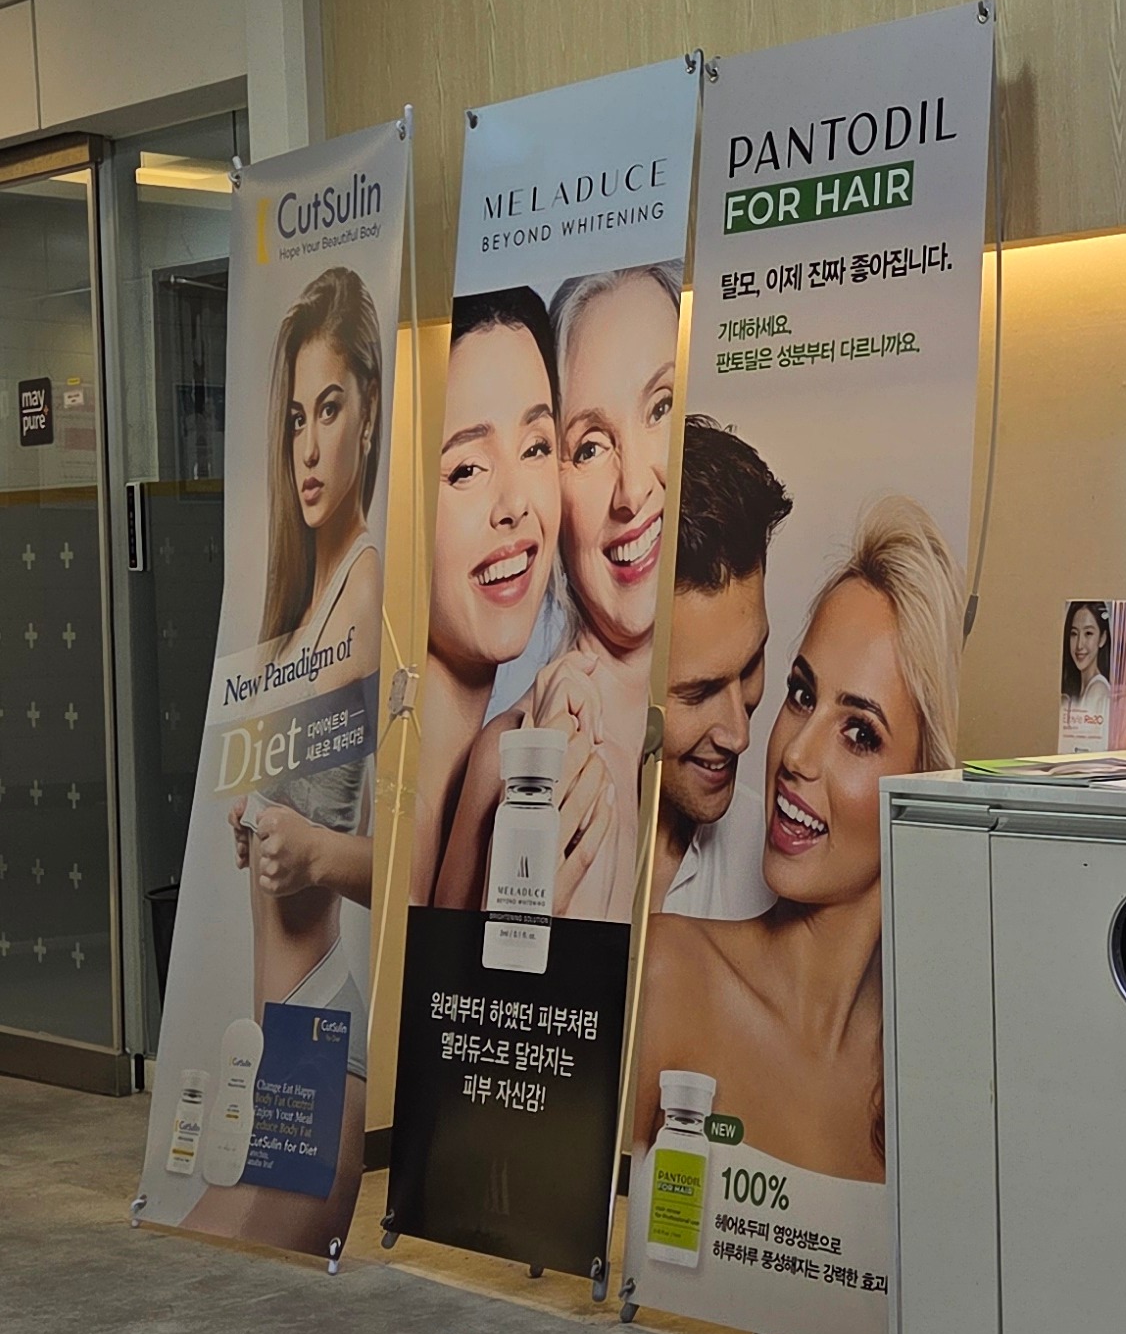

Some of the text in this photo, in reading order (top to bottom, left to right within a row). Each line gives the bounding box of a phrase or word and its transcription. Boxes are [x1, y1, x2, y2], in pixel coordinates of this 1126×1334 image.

[729, 97, 957, 178] PANTODIL
[278, 174, 381, 239] CutSulin
[483, 158, 668, 221] MELADUCE
[726, 168, 911, 230] FOR HAIR
[279, 223, 381, 260] Hope Your Beautiful Body
[482, 202, 664, 252] BEYOND WHITENING
[721, 242, 952, 300] 탈모, 이제 진짜 좋아집니다.
[718, 315, 792, 342] 기대하세요.
[716, 332, 920, 373] 판토딜은 성분부터 다르니까요.
[22, 389, 45, 413] may
[23, 413, 45, 436] pure
[223, 626, 355, 706] New Paradigm of
[307, 709, 348, 738] 다이어트의
[214, 717, 302, 792] Diet
[497, 886, 546, 898] MELADUCE
[430, 991, 599, 1041] 원래부터 하얬던 피부처럼
[441, 1032, 575, 1077] 멜라듀스로 달라지는
[462, 1073, 547, 1113] 피부 자신감!
[250, 1134, 317, 1156] CutSulin for Diet
[711, 1121, 736, 1139] NEW
[721, 1166, 790, 1211] 100%
[714, 1214, 842, 1255] 헤어&두피 영양성분으로
[713, 1240, 759, 1266] 하루하루
[761, 1250, 820, 1280] 풍성해지는
[822, 1264, 858, 1288] 강력한
